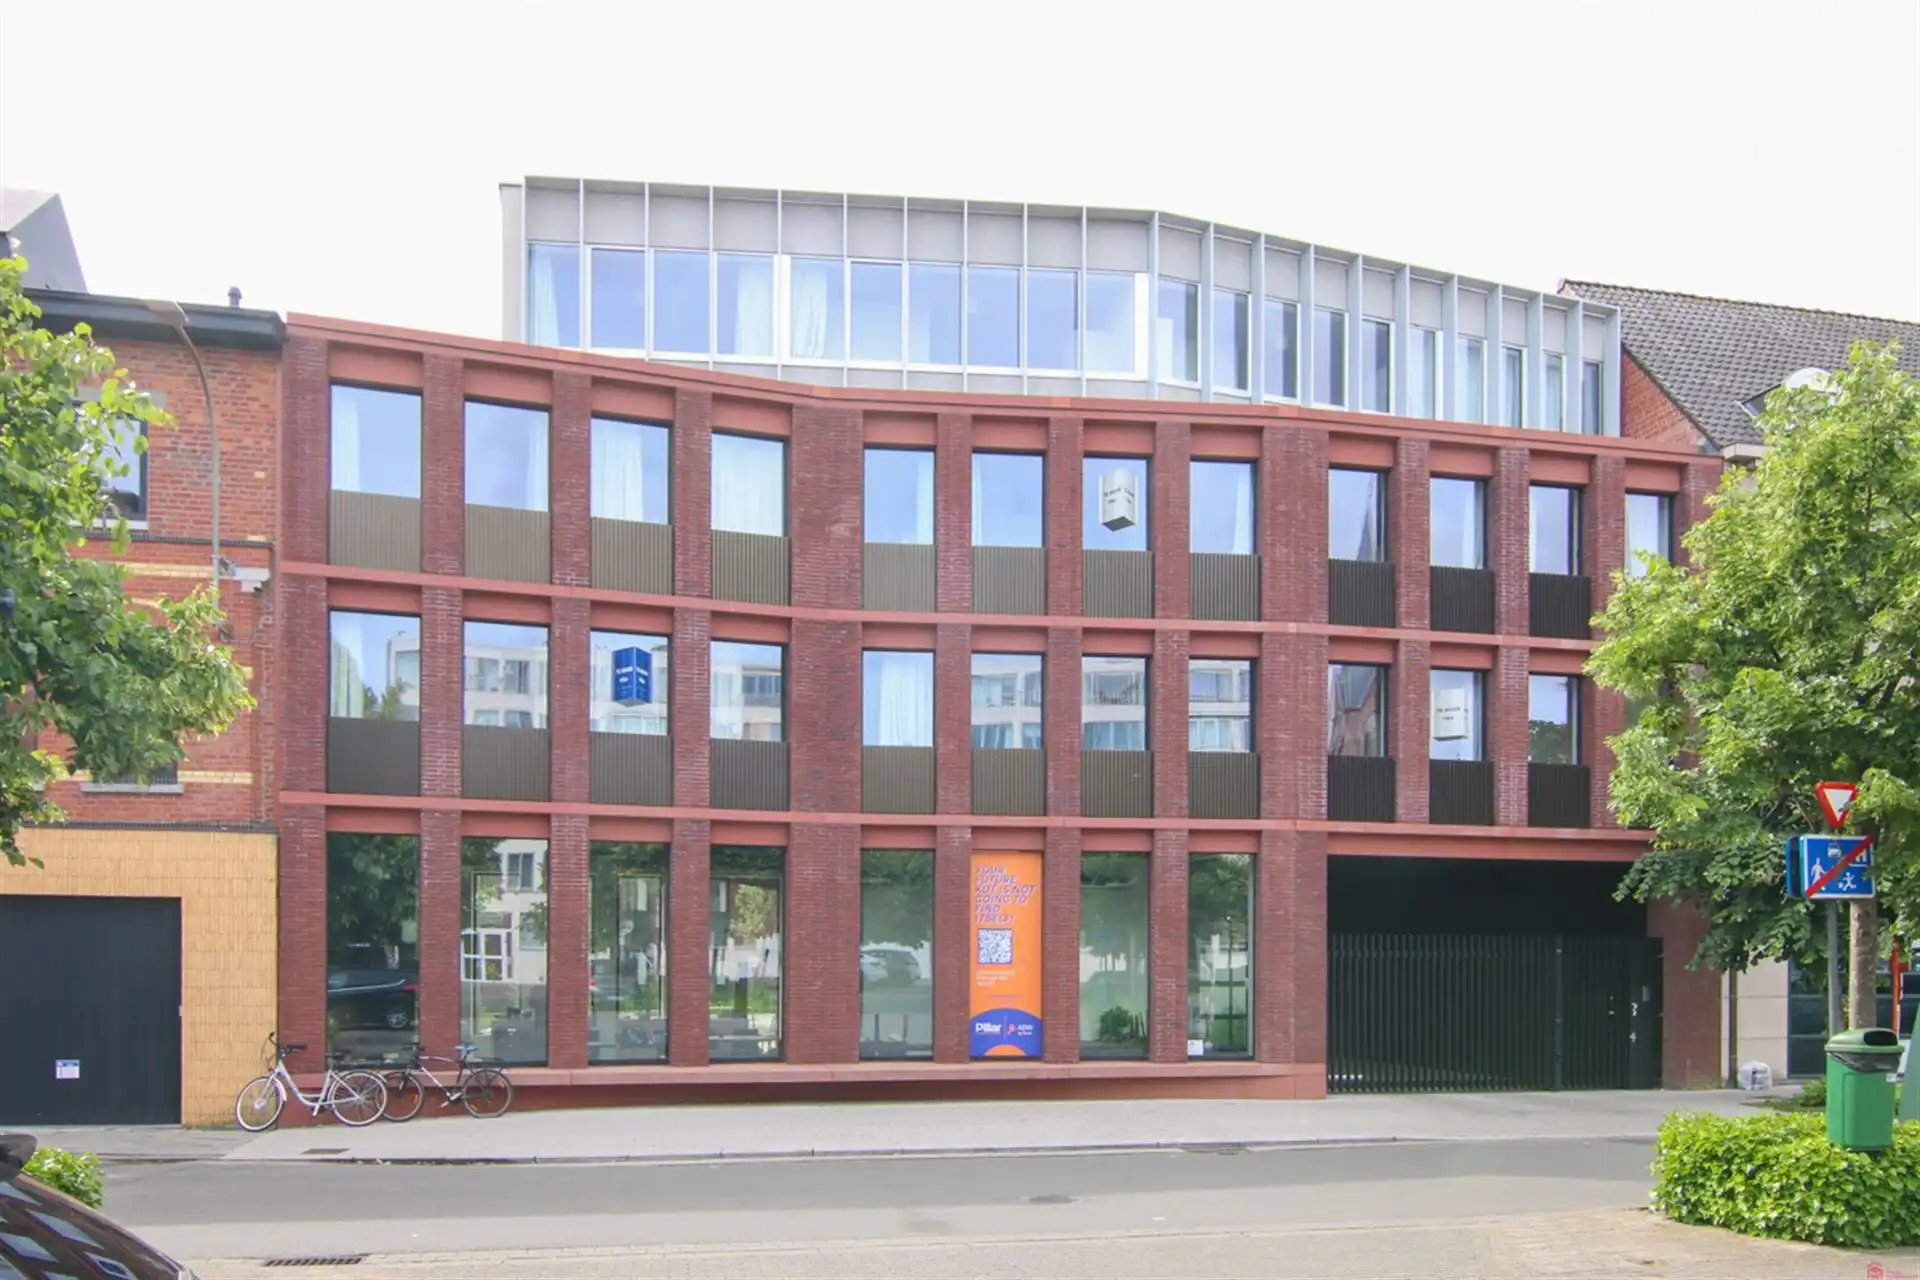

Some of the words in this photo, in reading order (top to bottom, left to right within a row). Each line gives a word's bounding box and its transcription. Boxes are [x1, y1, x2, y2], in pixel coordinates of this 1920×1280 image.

[975, 875, 1017, 884] FUTURE
[975, 885, 996, 895] KOT
[1012, 885, 1035, 895] NOT
[975, 895, 1010, 905] GOING
[1013, 895, 1028, 905] TO
[975, 904, 1001, 914] FIND
